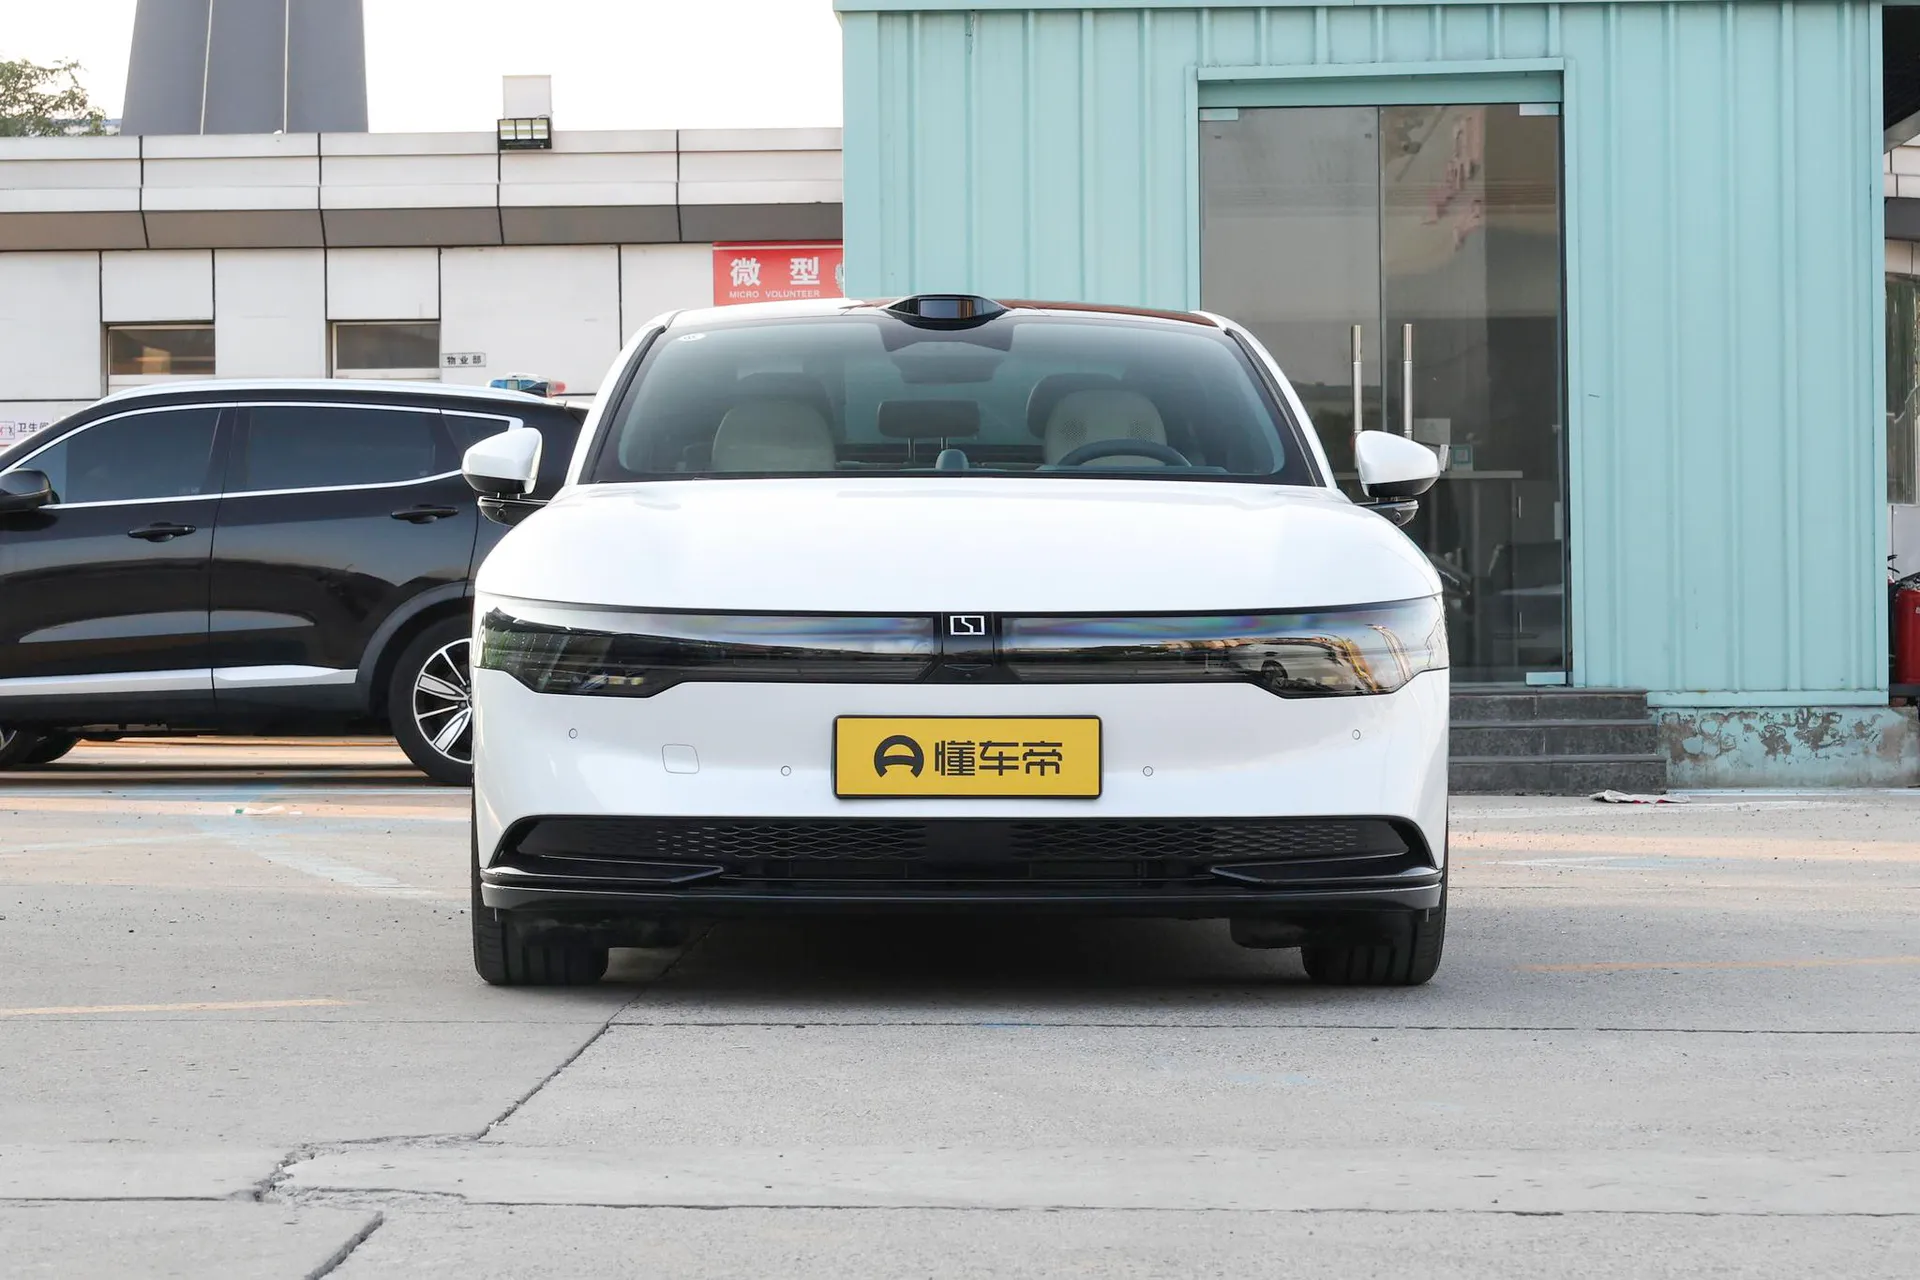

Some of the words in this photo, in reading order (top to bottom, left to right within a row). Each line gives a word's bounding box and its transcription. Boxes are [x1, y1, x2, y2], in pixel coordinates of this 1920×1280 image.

[730, 257, 821, 287] 微型
[729, 290, 760, 299] MICRO
[765, 289, 820, 298] VOLUNTEER
[446, 355, 482, 366] 物业部
[934, 740, 1063, 777] 懂车帝
